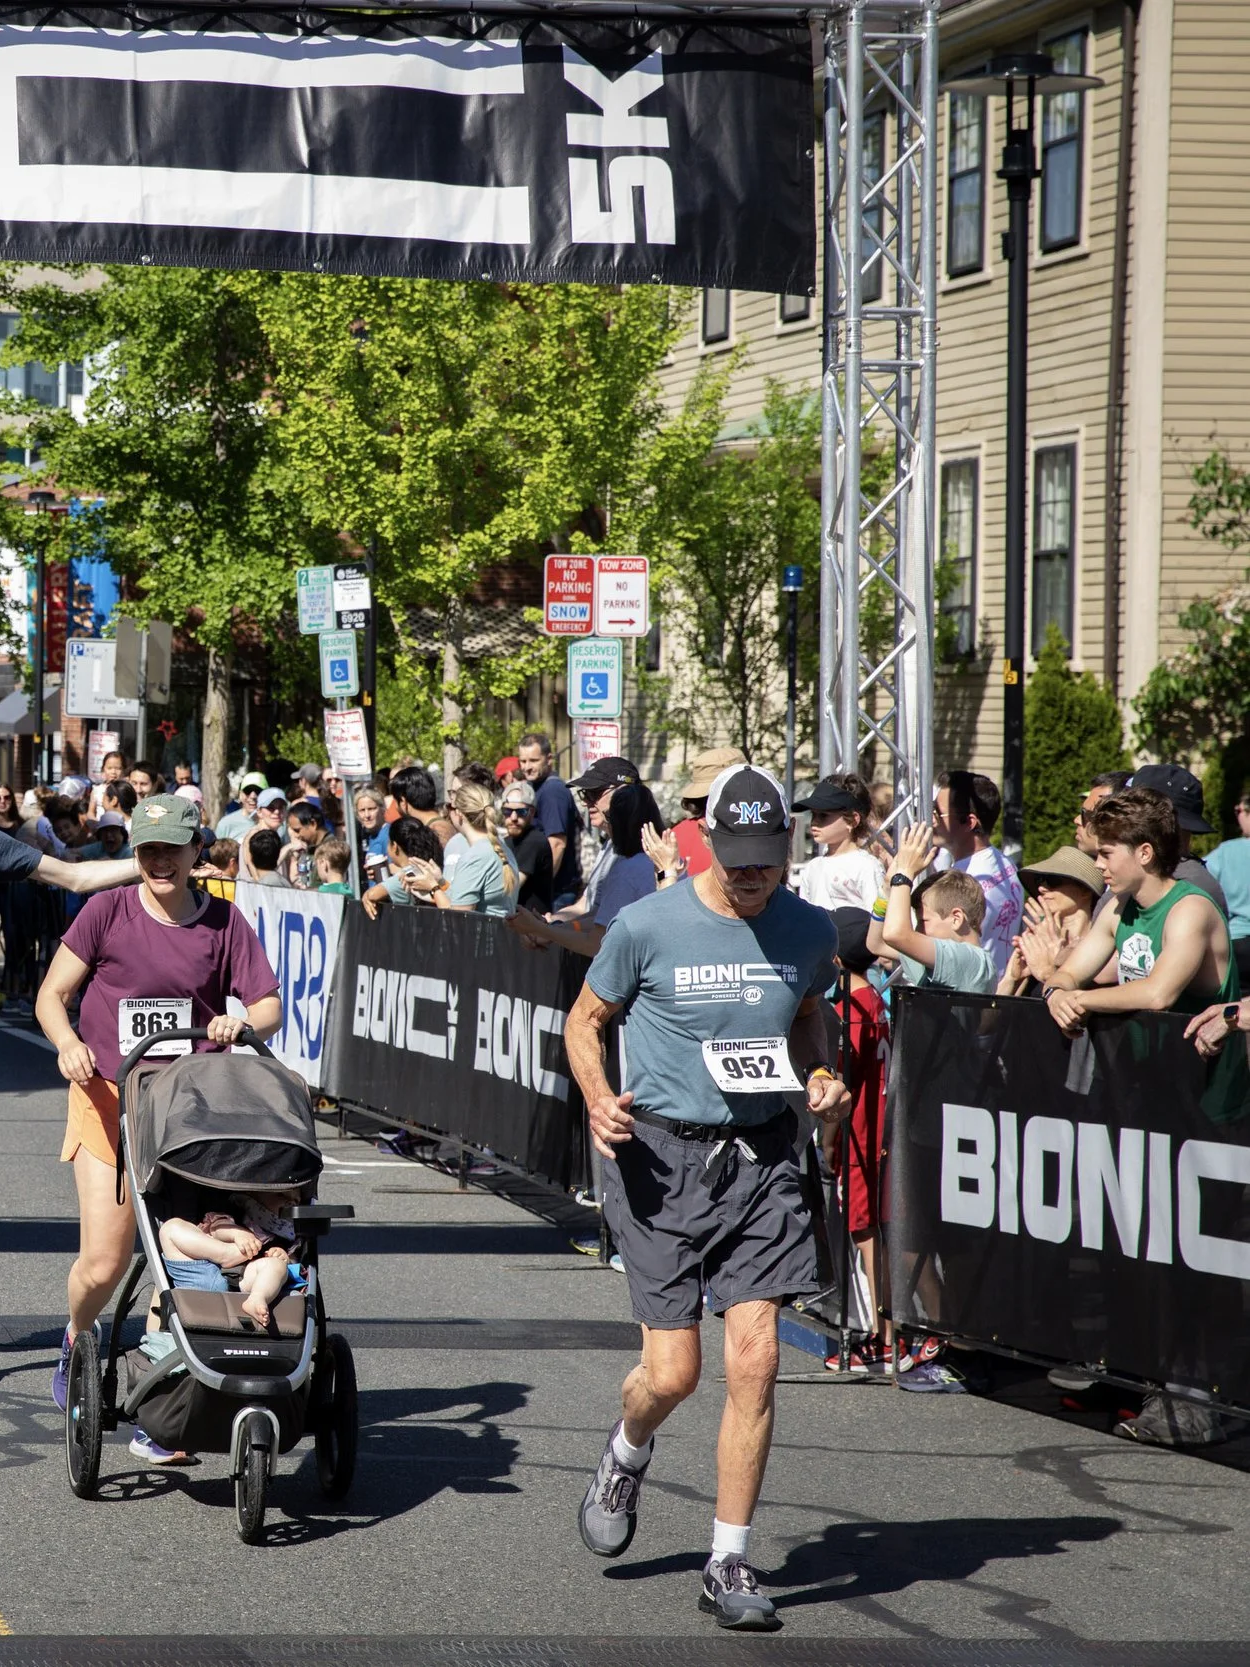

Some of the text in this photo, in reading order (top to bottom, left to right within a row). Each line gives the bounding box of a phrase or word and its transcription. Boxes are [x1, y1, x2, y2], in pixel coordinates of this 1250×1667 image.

[561, 42, 677, 245] 5K
[554, 559, 588, 569] TOW ZONE
[600, 560, 645, 570] TOW ZONE
[300, 571, 308, 586] 2
[562, 570, 578, 581] NO
[548, 581, 593, 594] PARKING
[615, 581, 629, 591] NO
[603, 599, 641, 609] PARKING
[550, 605, 589, 618] SNOW
[341, 611, 365, 624] 6920
[551, 622, 587, 632] EMERGENCY
[321, 637, 353, 647] RESERVED
[324, 648, 352, 657] PARKING
[572, 645, 618, 656] RESERVED
[575, 660, 615, 670] PARKING
[333, 735, 361, 743] PARKNG
[589, 740, 601, 750] NO
[739, 801, 762, 825] M
[674, 963, 783, 985] BIONIC
[674, 984, 690, 993] SAN
[691, 982, 730, 992] FRANCISCO
[126, 999, 175, 1008] BIONIC
[352, 964, 447, 1060] BIONIC
[131, 1011, 178, 1037] 863
[473, 987, 571, 1102] BIONIC
[711, 1039, 768, 1052] BIONIC
[721, 1054, 782, 1080] 952
[940, 1102, 1250, 1281] BIONIC
